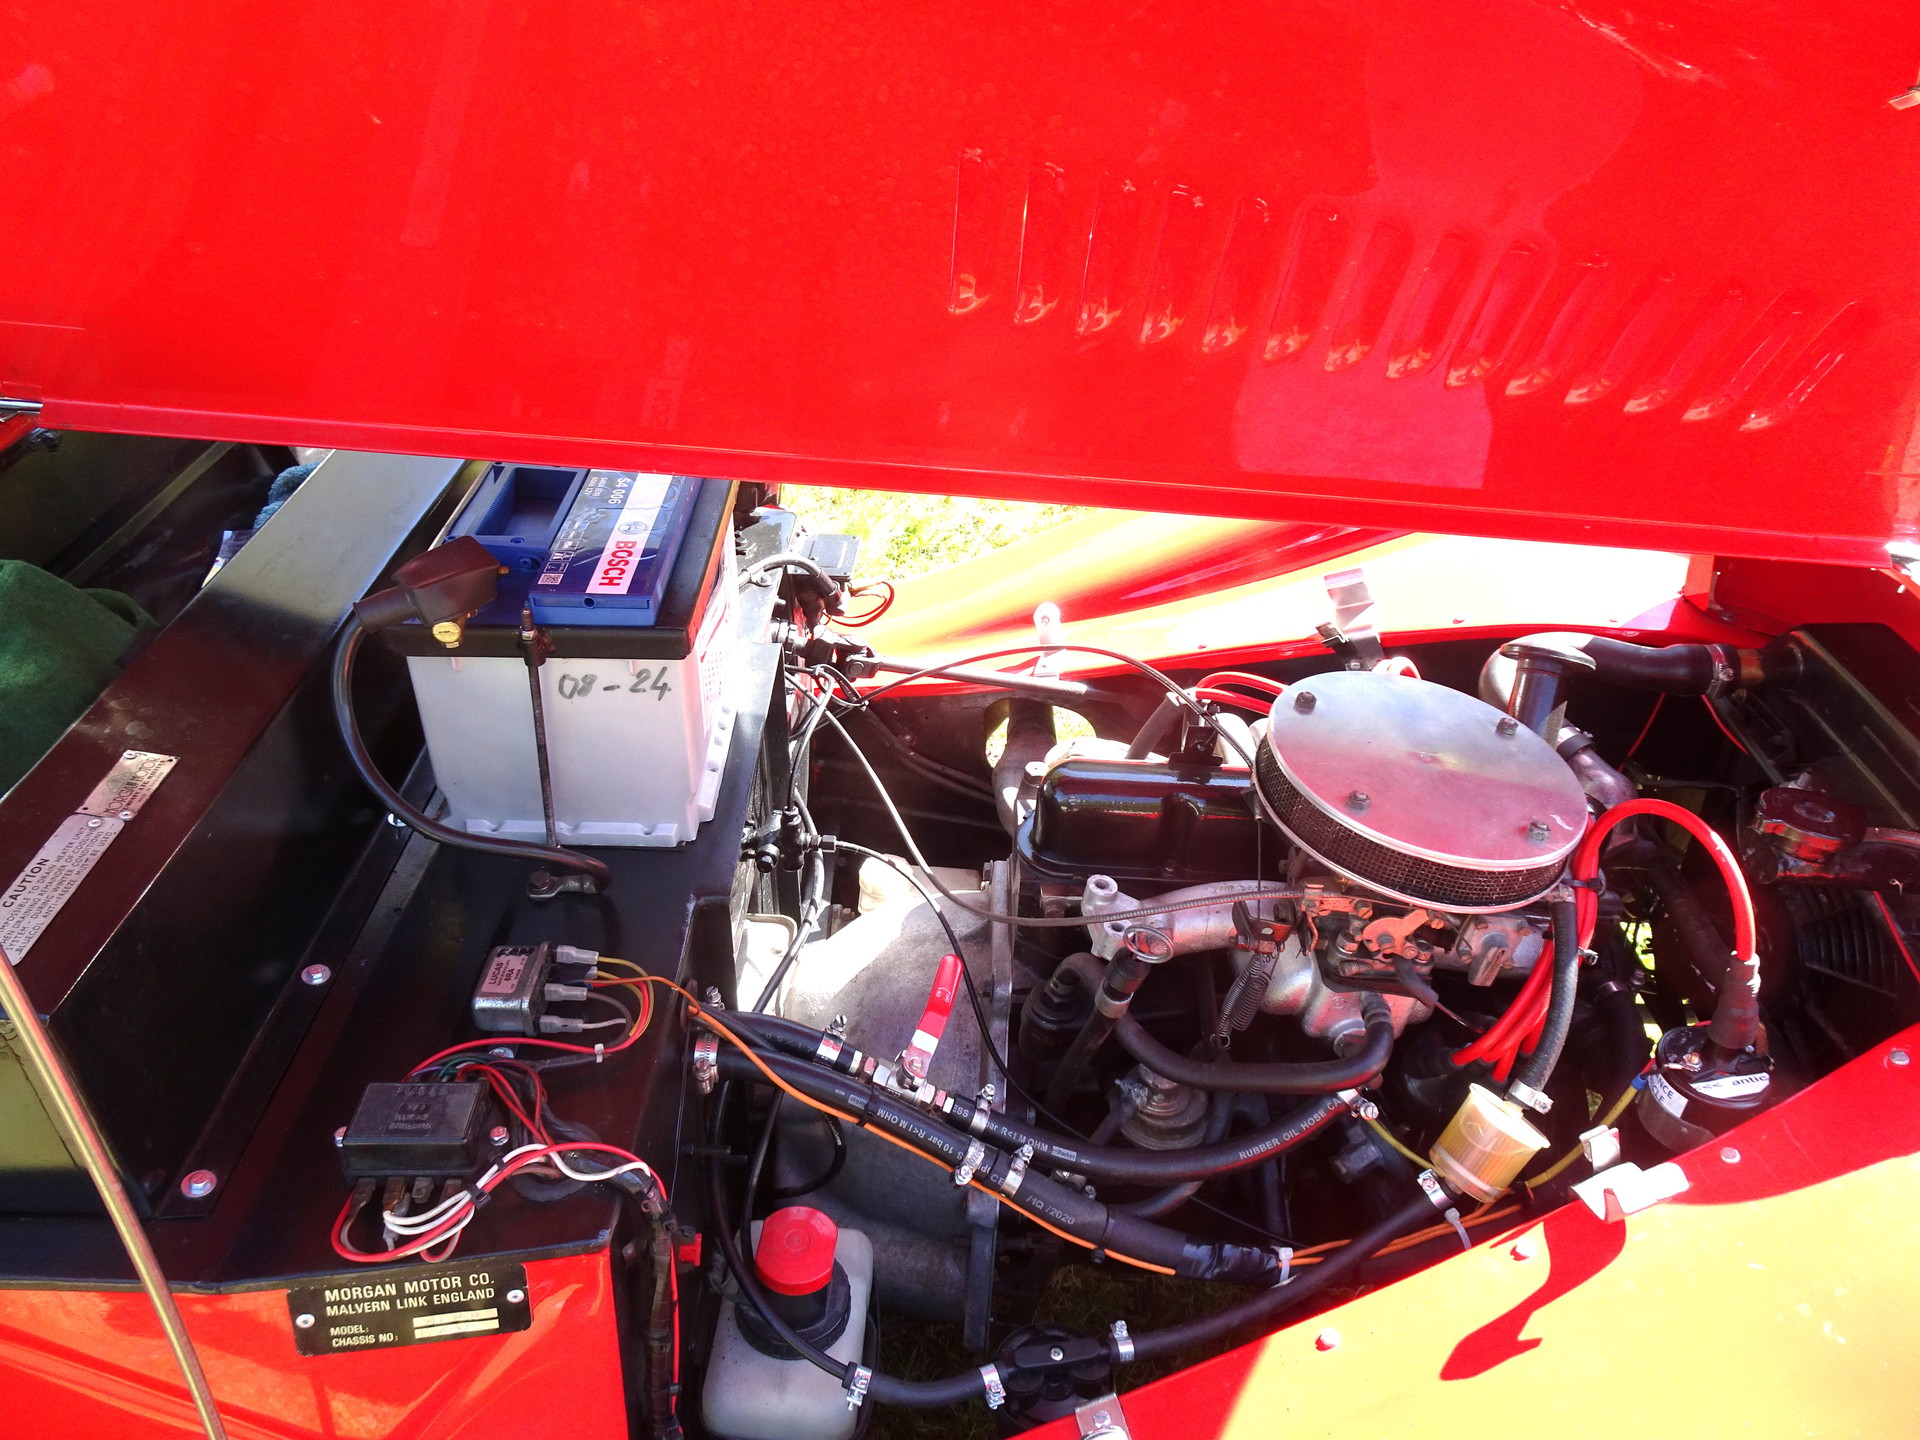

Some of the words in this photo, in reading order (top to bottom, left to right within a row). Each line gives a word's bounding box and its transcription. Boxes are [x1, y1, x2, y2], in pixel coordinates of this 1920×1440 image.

[608, 490, 625, 505] 006
[617, 477, 631, 491] S4
[598, 540, 638, 587] BOSCH
[28, 886, 39, 894] TO
[38, 865, 56, 886] DRAIN
[56, 845, 76, 862] HEATER
[73, 827, 87, 843] UNIT
[3, 858, 50, 908] CAUTION
[6, 927, 29, 951] SYSTEM
[31, 896, 55, 920] DURING
[54, 869, 73, 894] WINTER
[72, 831, 105, 868] CONDITIONS
[15, 922, 45, 954] BLUECOL
[42, 879, 78, 918] ANTI-FREEZE
[76, 858, 91, 877] MUST
[90, 848, 100, 860] BE
[98, 831, 114, 850] USED
[1, 930, 15, 947] HEN
[12, 898, 41, 929] DRAINING
[38, 864, 66, 898] REMAINDER
[66, 853, 75, 863] OF
[488, 962, 504, 985] LUCAS
[926, 1135, 944, 1149] bar
[942, 1143, 955, 1154] 10
[1239, 1137, 1281, 1160] RUBBER
[1283, 1128, 1300, 1141] OIL
[1302, 1109, 1327, 1131] HOSE
[324, 1283, 396, 1303] MORGAN
[404, 1276, 461, 1294] MOTOR
[469, 1272, 495, 1287] CO.
[326, 1300, 390, 1317] MALVERN
[396, 1296, 428, 1310] LINK
[433, 1288, 495, 1305] ENGLAND
[330, 1324, 369, 1337] MODEL:
[332, 1335, 375, 1348] CHASSIS
